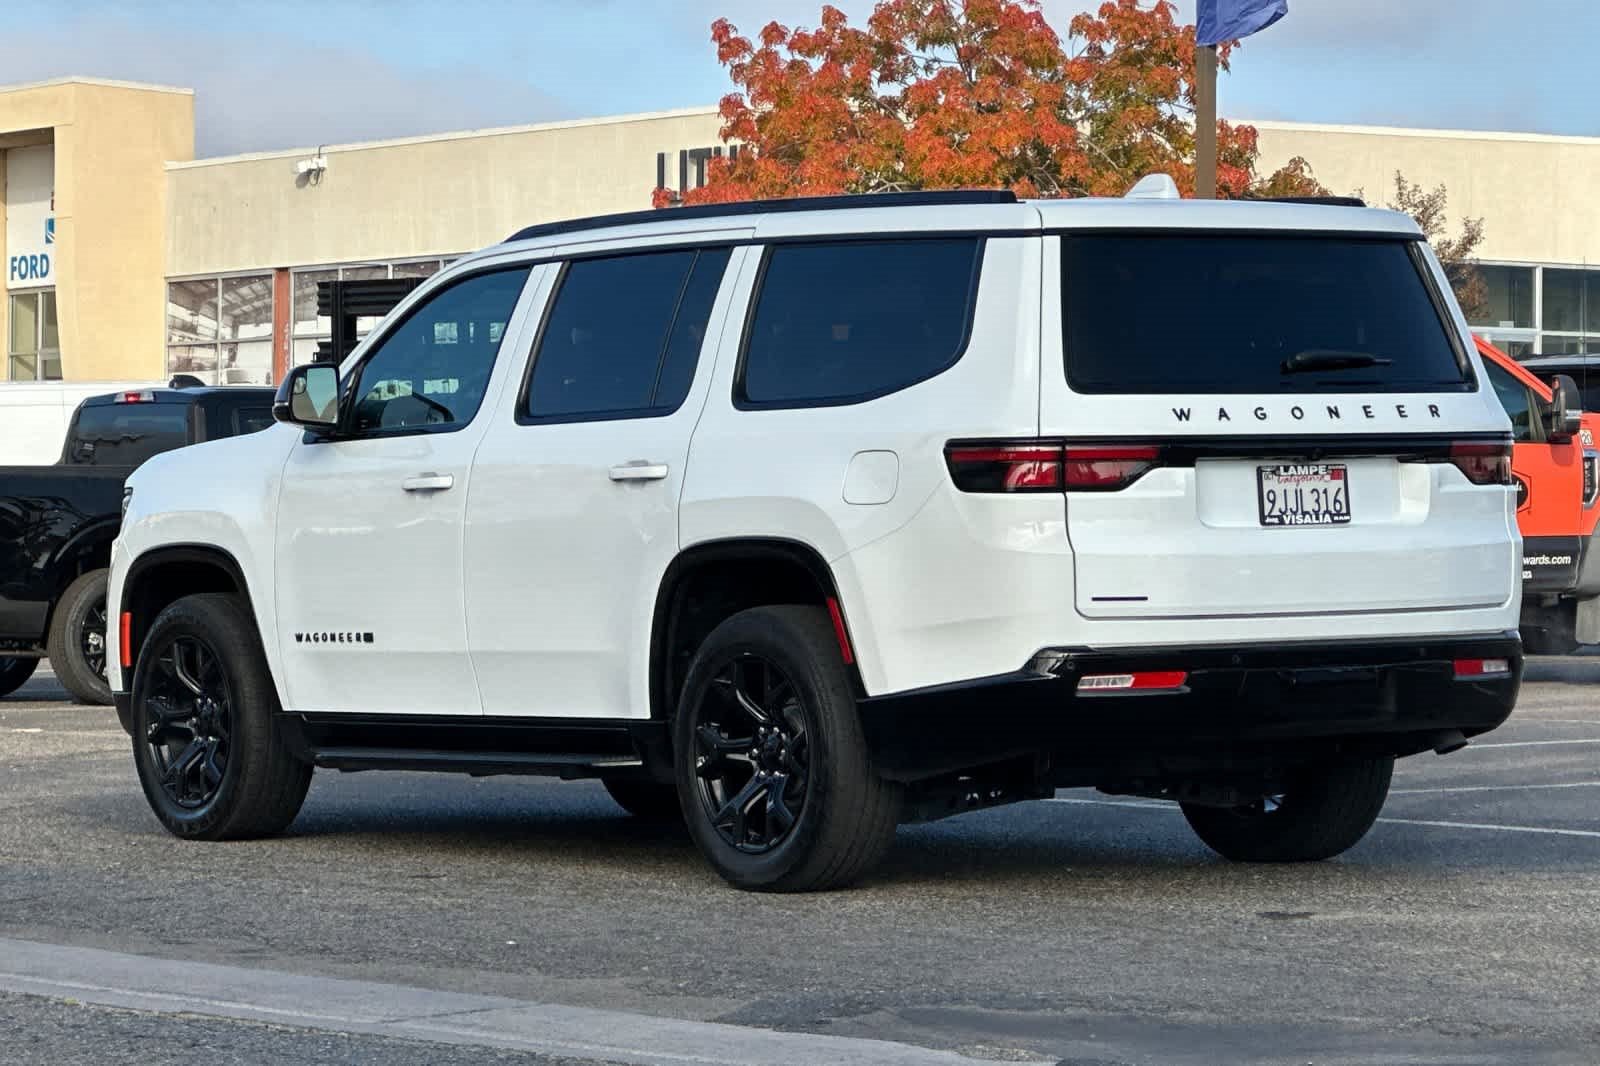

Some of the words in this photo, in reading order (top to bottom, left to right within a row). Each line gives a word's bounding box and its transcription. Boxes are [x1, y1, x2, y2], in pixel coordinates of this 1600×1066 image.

[10, 253, 50, 281] FORD
[1172, 404, 1441, 422] WAGONEER
[1280, 465, 1327, 475] LAMPE
[1267, 488, 1342, 515] 9JJL316
[1283, 513, 1332, 524] VISALIA
[1522, 554, 1571, 565] wards.com
[295, 631, 362, 643] WAGONEER
